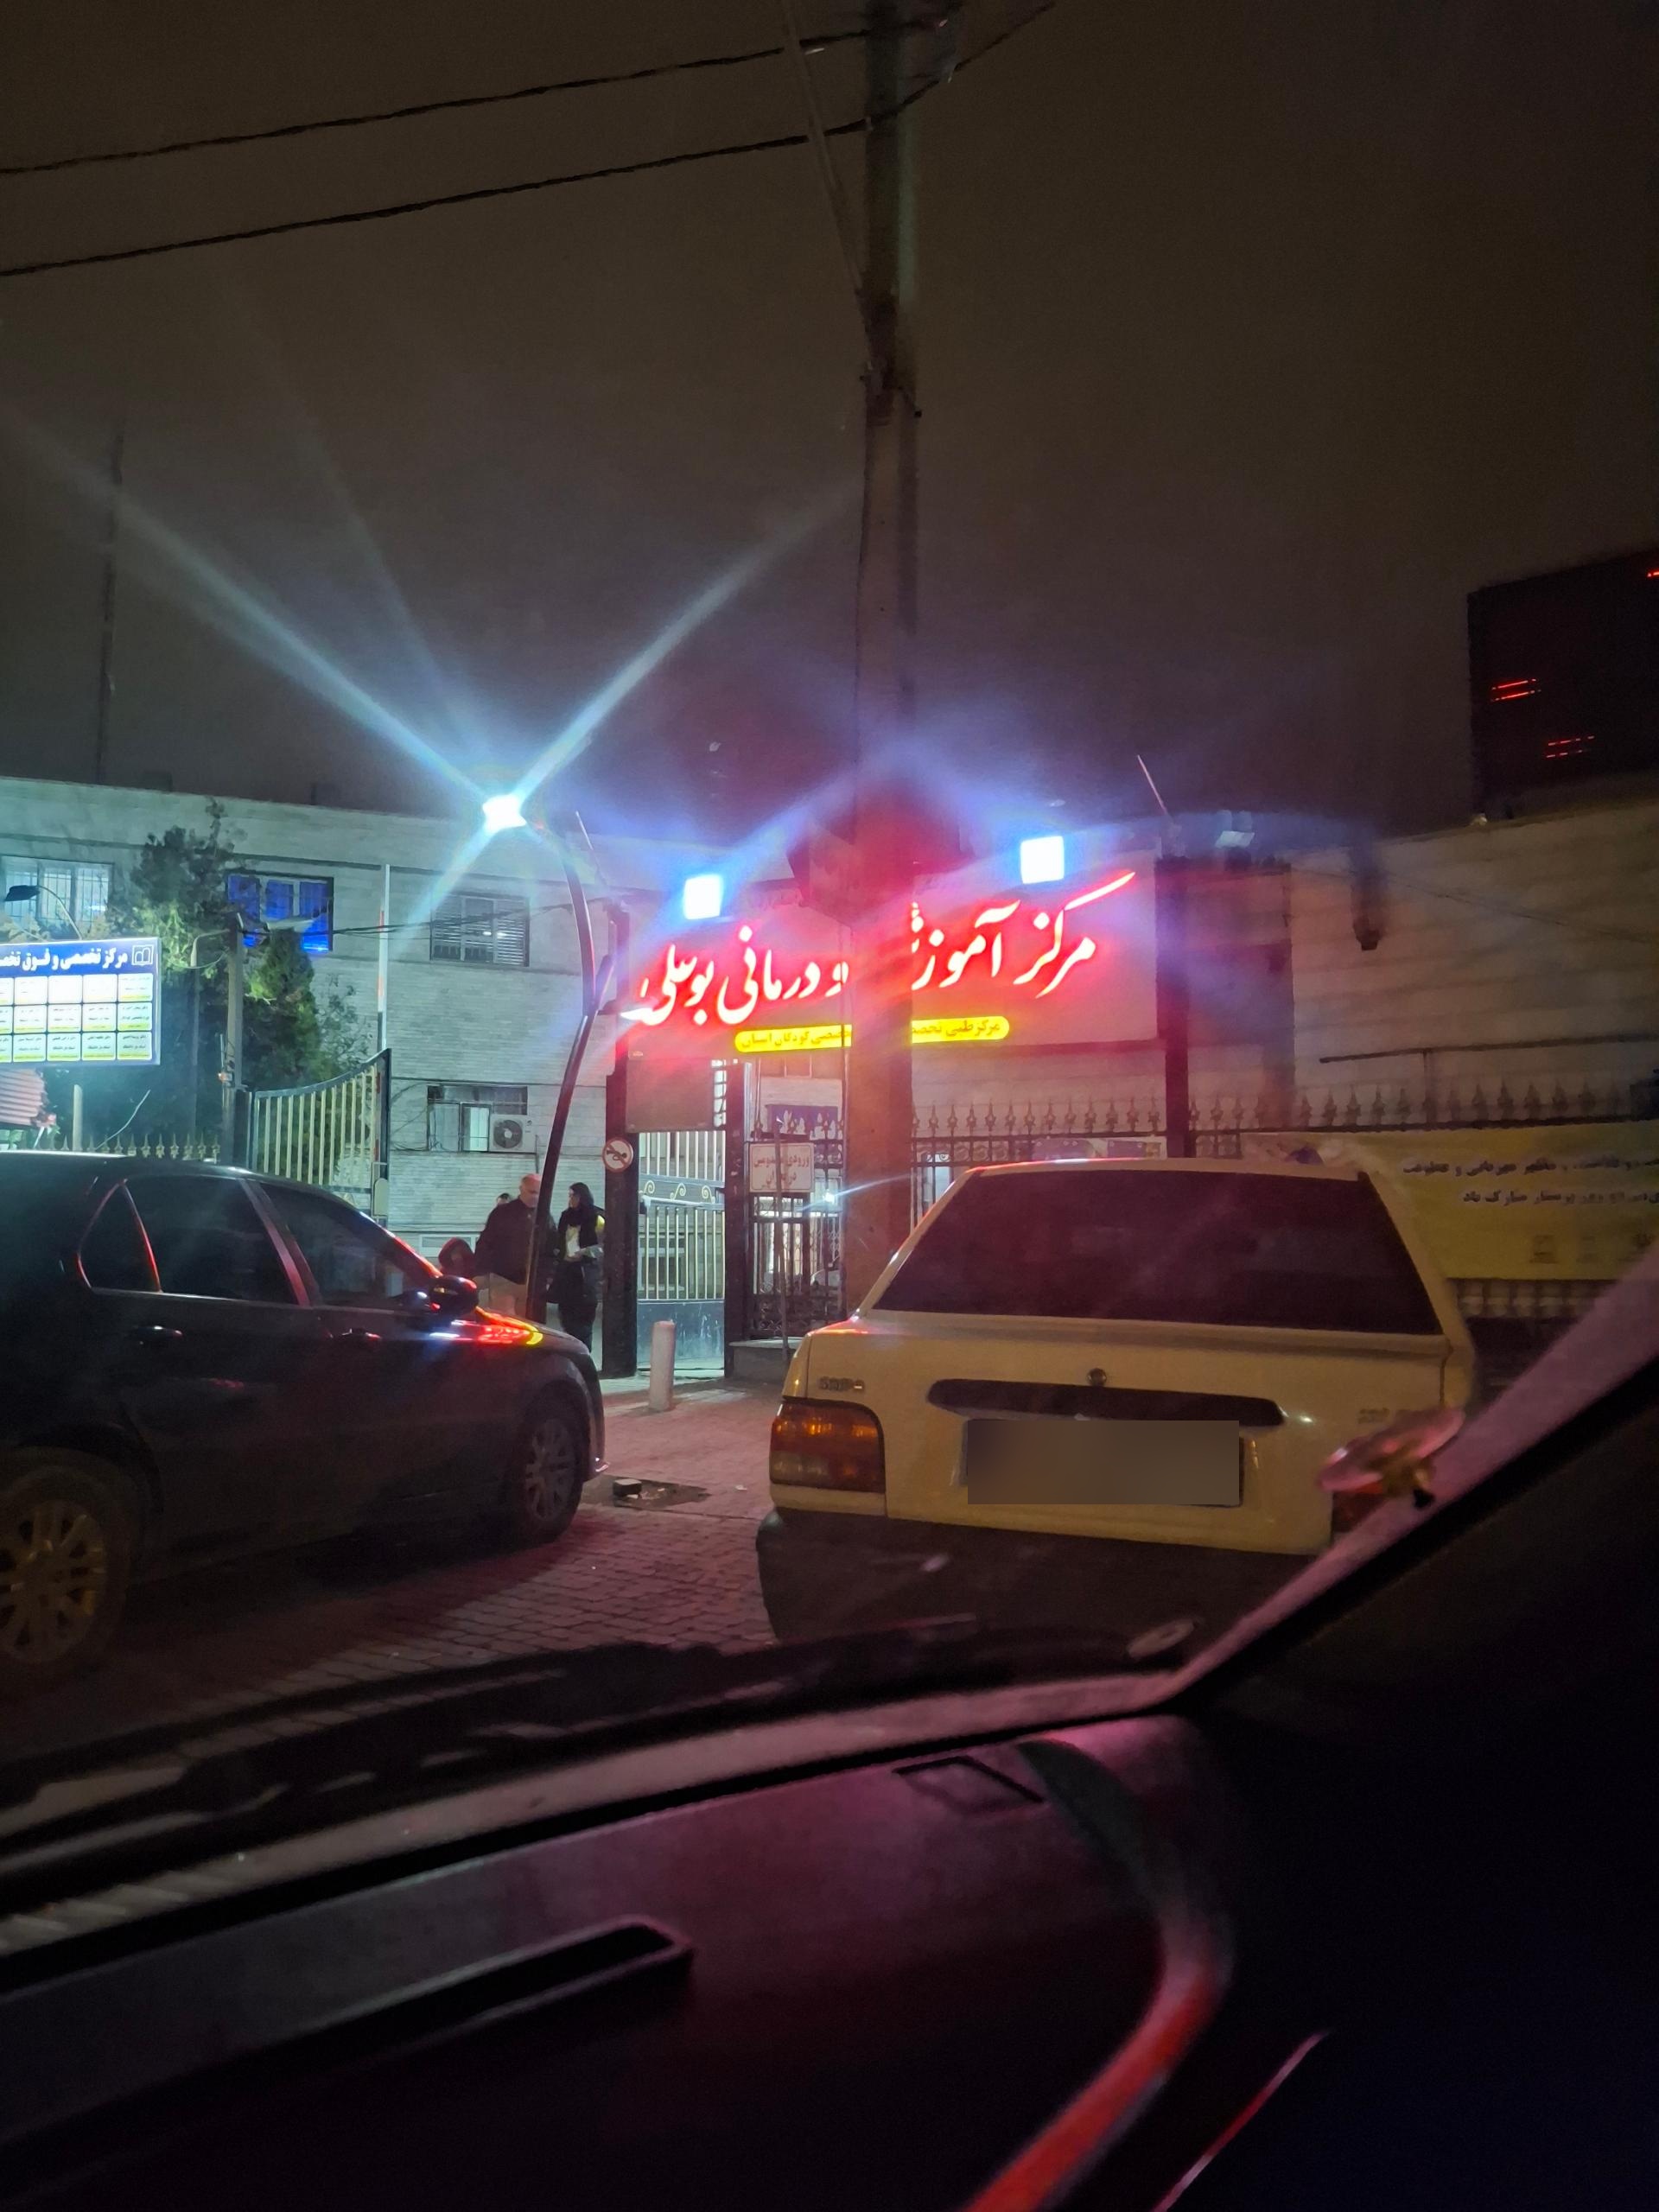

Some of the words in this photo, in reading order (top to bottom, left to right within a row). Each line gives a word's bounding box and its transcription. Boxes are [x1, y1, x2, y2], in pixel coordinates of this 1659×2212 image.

[911, 899, 1021, 991] آموز
[1013, 872, 1136, 999] مرکز
[0, 951, 22, 967] تخص
[22, 948, 51, 971] فوق
[52, 955, 60, 970] و
[60, 948, 102, 970] تخصصی
[102, 947, 129, 969] مرکز
[639, 944, 715, 1027] بوعلی
[716, 925, 821, 1026] درمانی
[824, 961, 849, 997] و
[774, 1030, 810, 1047] کودکان
[945, 1020, 974, 1038] طبی
[974, 1019, 1001, 1037] مرکز
